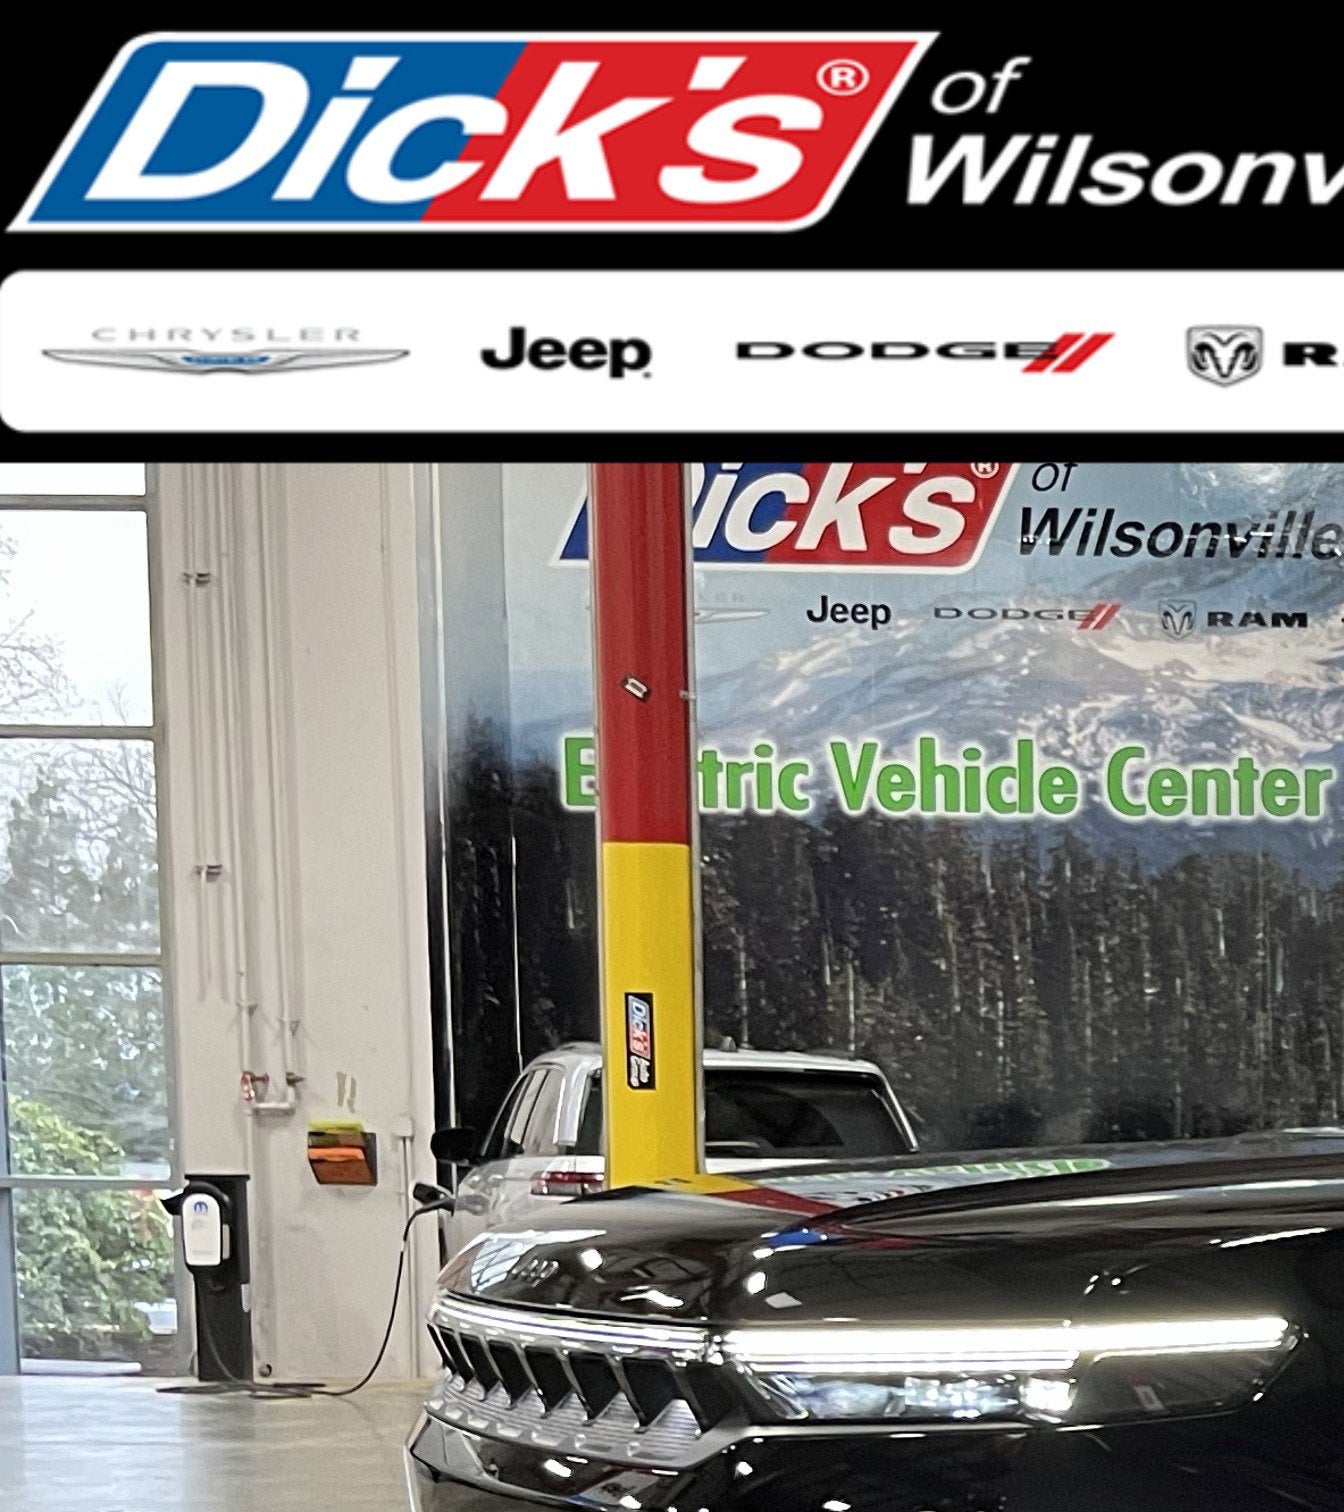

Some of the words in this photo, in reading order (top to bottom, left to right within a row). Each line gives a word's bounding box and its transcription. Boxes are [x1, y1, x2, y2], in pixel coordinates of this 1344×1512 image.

[1030, 463, 1080, 493] of
[692, 463, 976, 555] icks
[805, 594, 892, 630] Jeep
[933, 606, 1097, 622] DODGE
[1206, 610, 1309, 630] RAM
[564, 737, 810, 811] Etric
[830, 737, 1078, 814] Vehicle
[1106, 746, 1333, 818] Center
